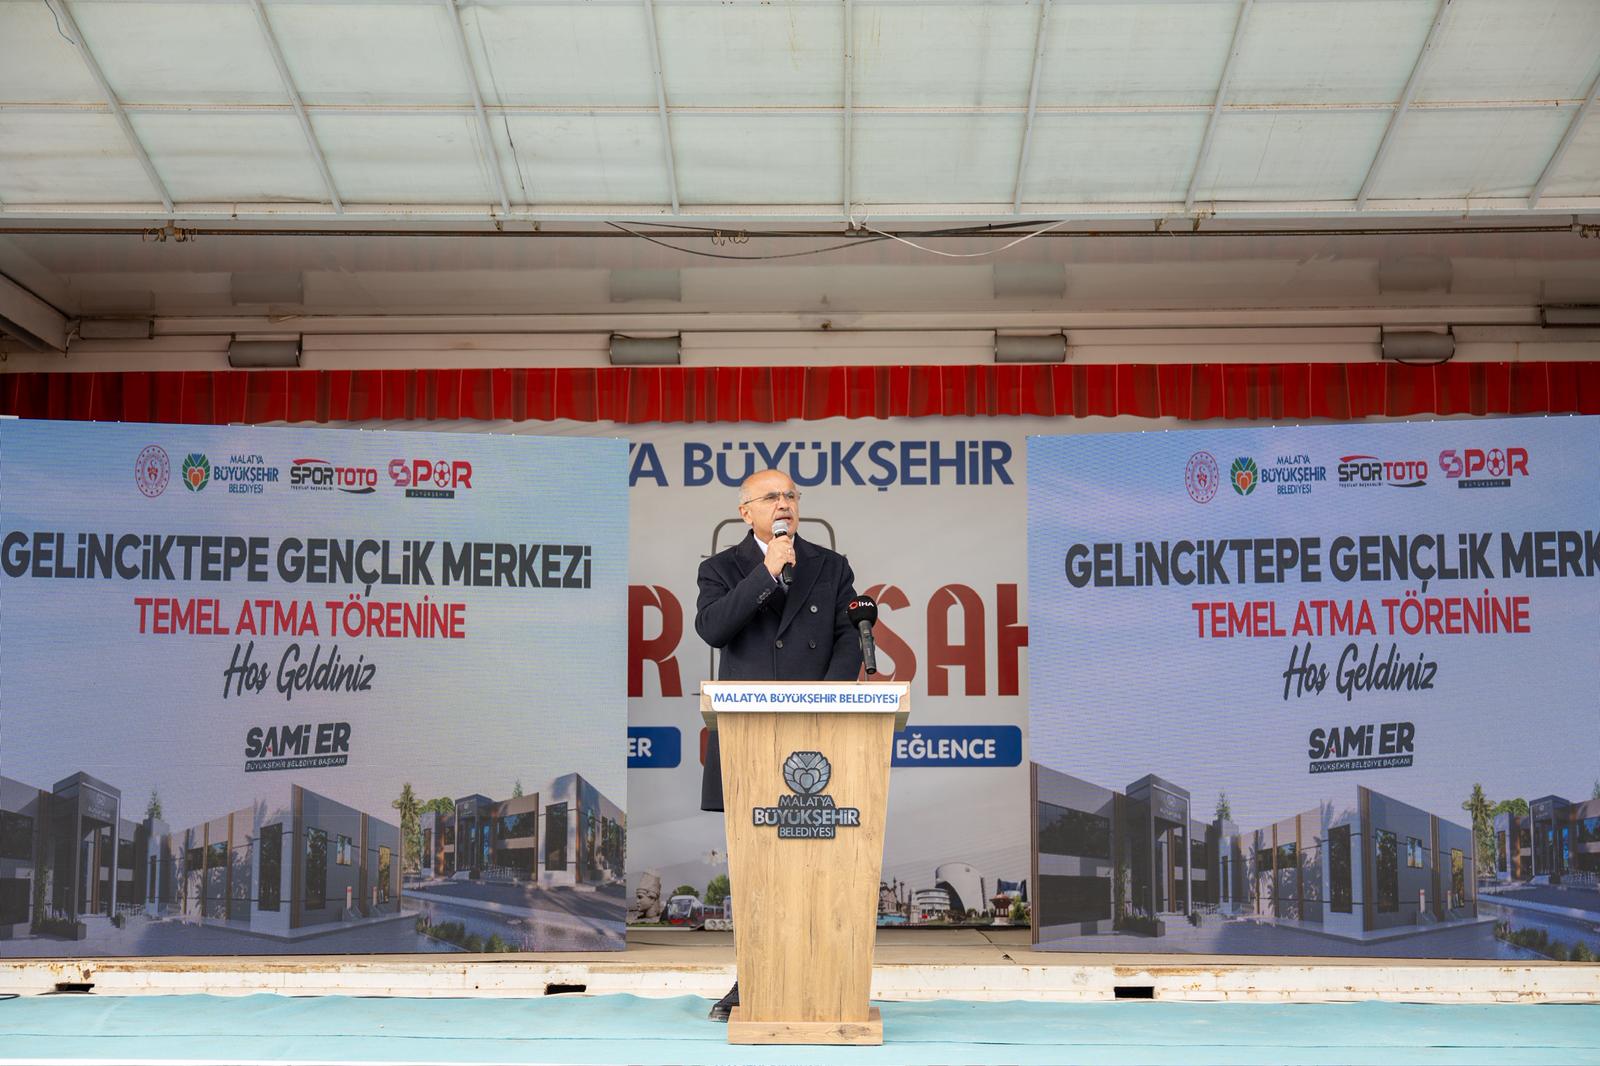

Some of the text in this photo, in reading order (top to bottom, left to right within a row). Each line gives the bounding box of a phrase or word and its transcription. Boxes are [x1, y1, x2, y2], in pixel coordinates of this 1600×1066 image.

[213, 466, 279, 482] BÜYÜKŞEHİR
[229, 454, 264, 465] MALATYA
[628, 440, 1013, 492] A BÜYÜKŞEHİR
[1261, 466, 1327, 483] BÜYÜKŞEHİR
[1276, 454, 1311, 465] MALATYA
[1, 531, 592, 597] GELİNCİKTEPE GENÇLİK MERKEZİ
[1064, 536, 1322, 588] GELİNCİKTEPE
[1329, 533, 1495, 594] GENÇLİK
[134, 594, 466, 639] TEMEL ATMA TÖRENİNE
[1192, 588, 1531, 638] TEMEL ATMA TÖRENİNE
[223, 640, 376, 701] Hoş Geldiniz
[1283, 641, 1438, 701] Hoş Geldiniz
[713, 693, 899, 705] MALATYA BÜYÜKŞEHİR BELEDİYESİ
[245, 721, 352, 758] SAMİ ER
[896, 733, 997, 759] EĞLENCE
[1308, 721, 1416, 760] SAMİ ER
[780, 796, 834, 807] MALATYA
[754, 809, 859, 827] BÜYÜKŞEHİR
[779, 827, 834, 837] BELEDİYESİ
